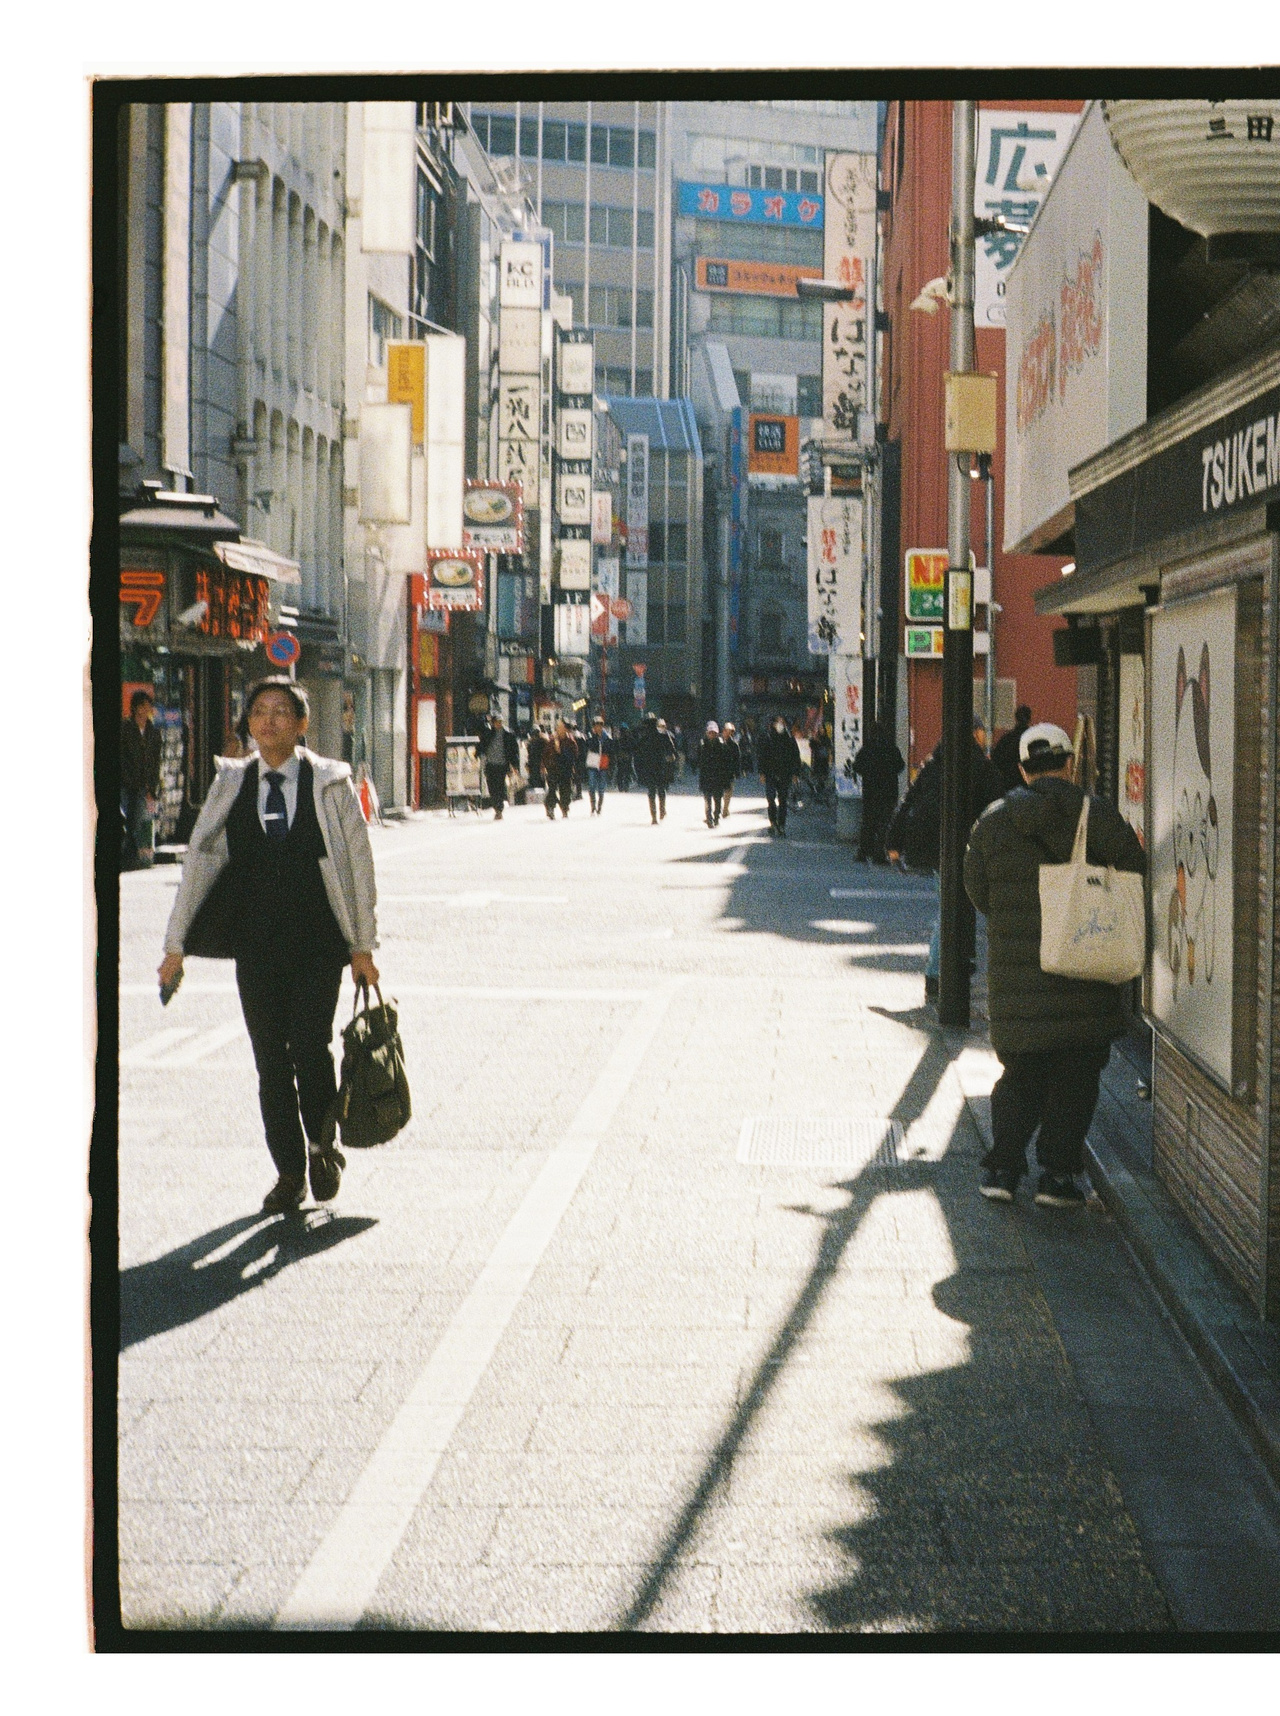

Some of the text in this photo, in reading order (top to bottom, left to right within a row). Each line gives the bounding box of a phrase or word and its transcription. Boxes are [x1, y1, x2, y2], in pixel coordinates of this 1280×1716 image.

[697, 187, 820, 222] カラオケ
[913, 555, 949, 586] NP
[119, 571, 165, 626] ラ
